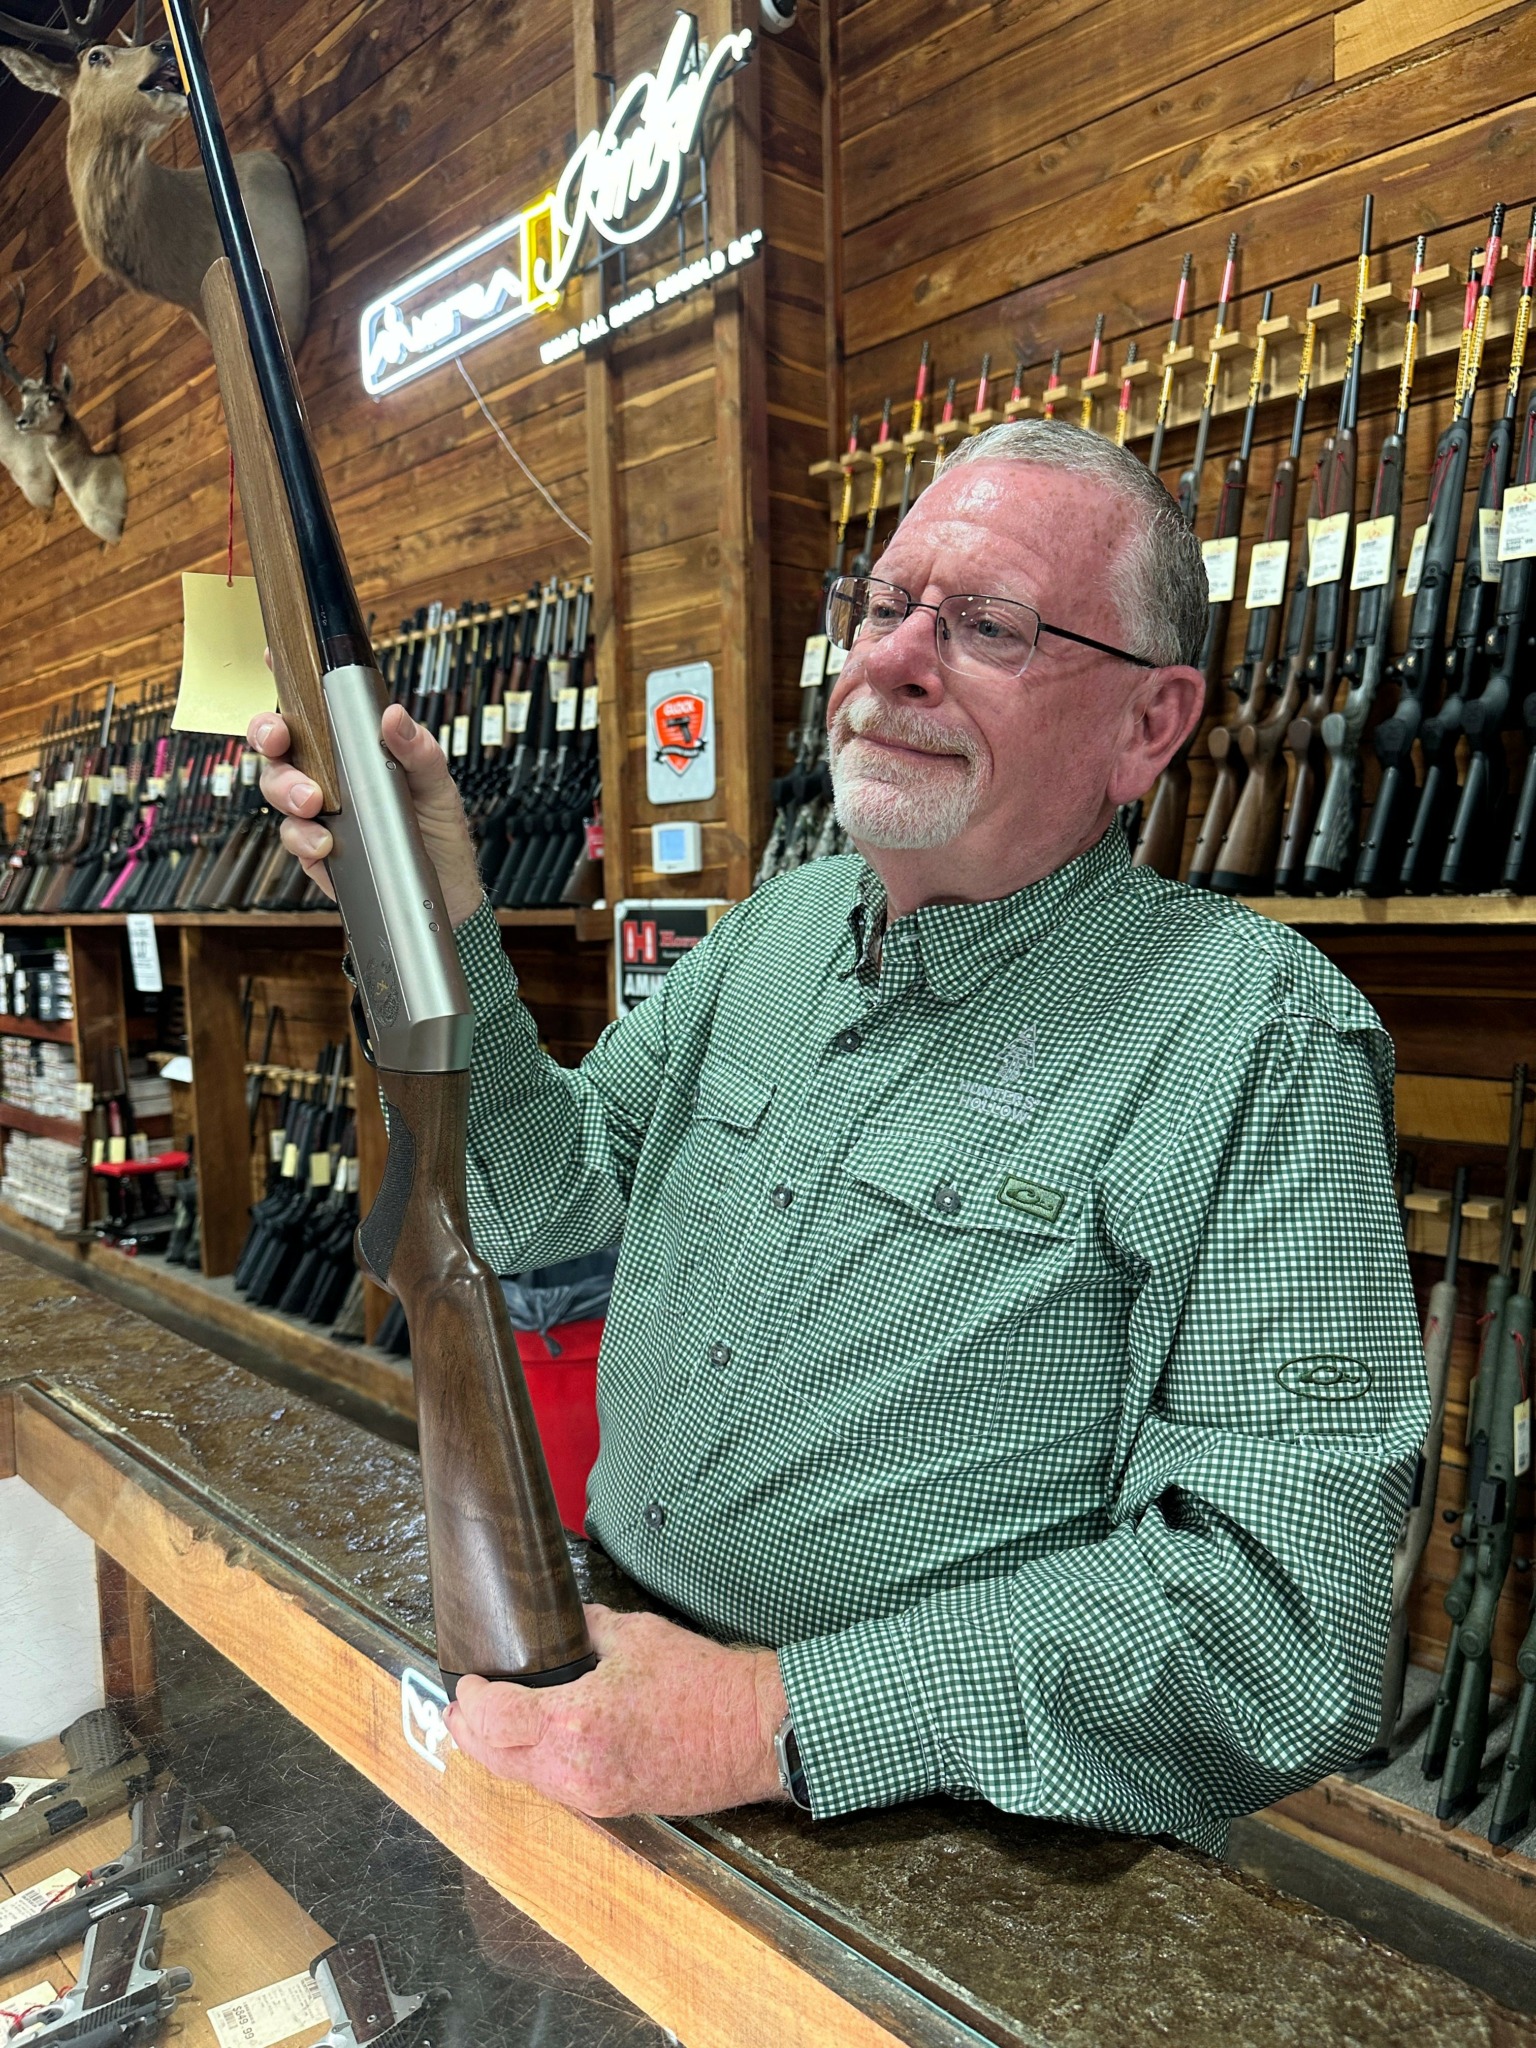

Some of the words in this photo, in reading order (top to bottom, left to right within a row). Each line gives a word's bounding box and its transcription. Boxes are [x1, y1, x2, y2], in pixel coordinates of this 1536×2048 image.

[663, 700, 696, 717] GLOCK
[659, 930, 700, 949] Horn
[958, 1096, 1029, 1123] HOLLOW
[232, 2005, 255, 2040] $849.99
